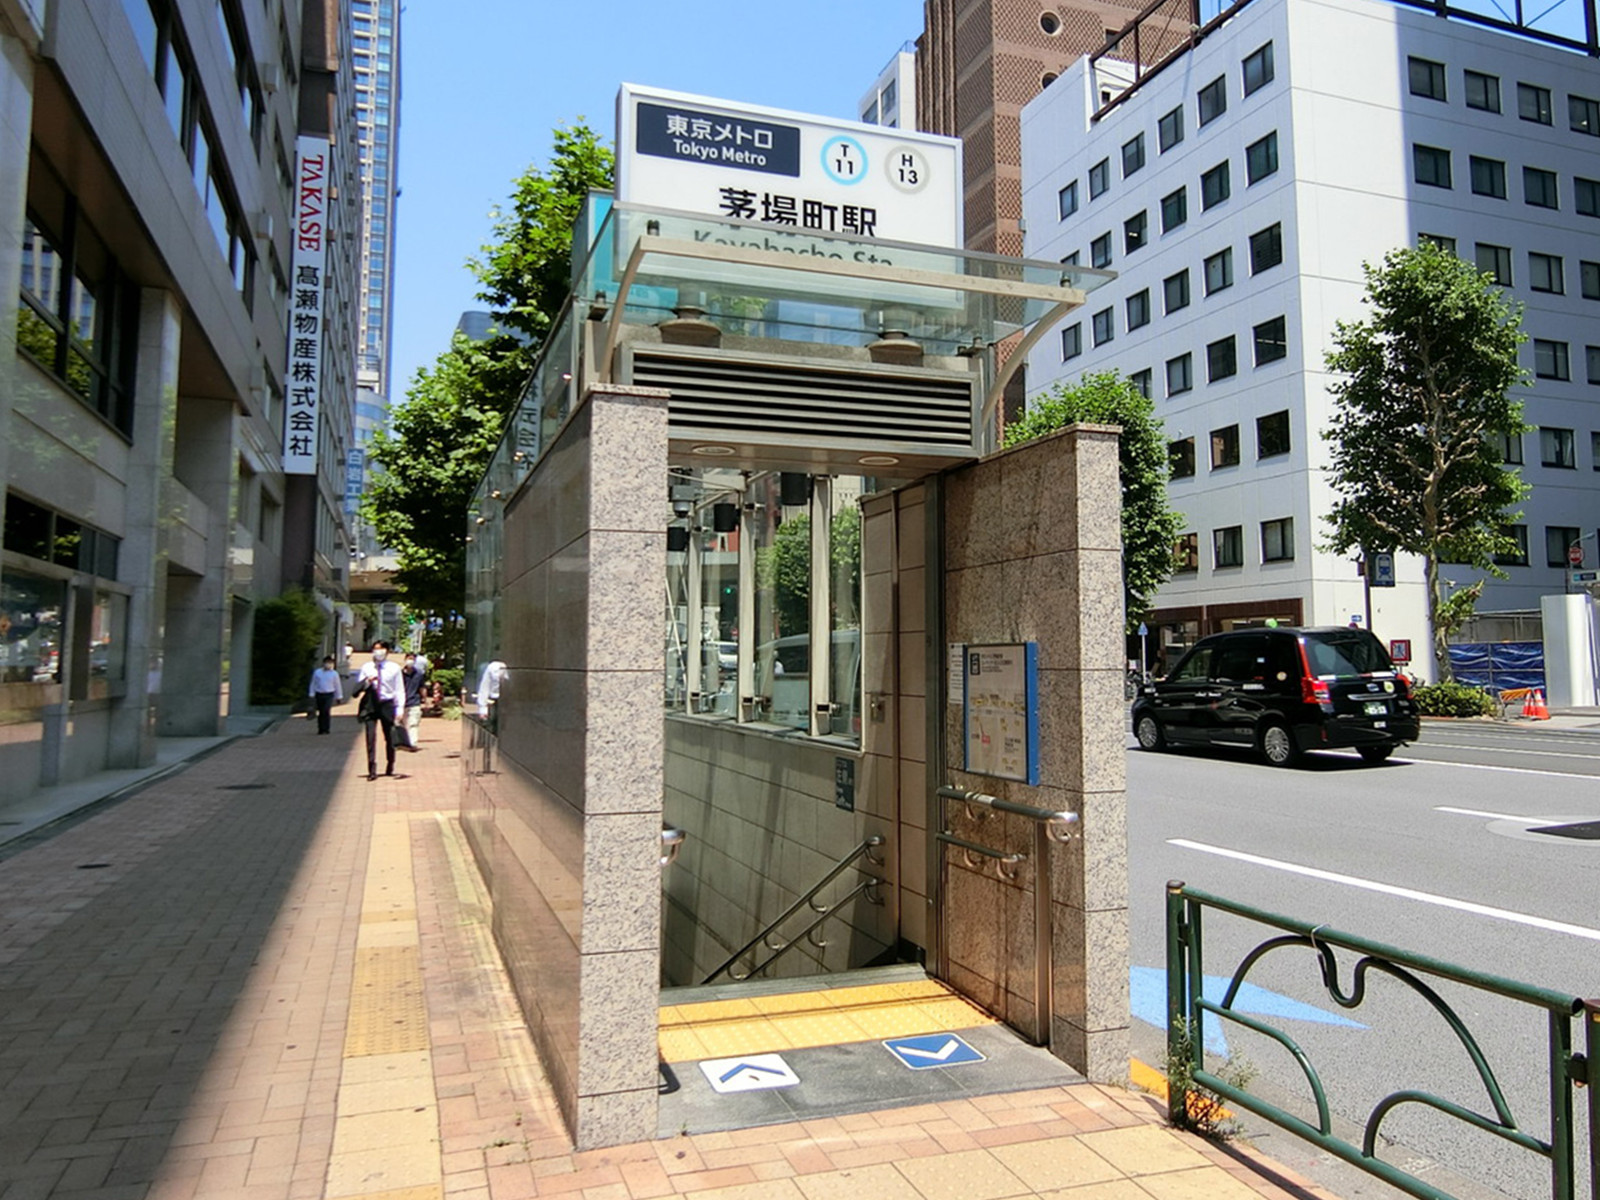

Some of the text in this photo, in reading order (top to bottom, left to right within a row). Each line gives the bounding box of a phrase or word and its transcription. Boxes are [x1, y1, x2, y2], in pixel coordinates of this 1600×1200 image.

[666, 114, 773, 149] 東京メトロ
[673, 138, 766, 166] Tokyo Metro
[840, 144, 850, 157] T
[902, 154, 913, 167] H
[836, 158, 853, 175] 11
[898, 168, 918, 185] 13
[298, 154, 324, 252] TAKASE
[719, 187, 877, 242] 茅場町駅
